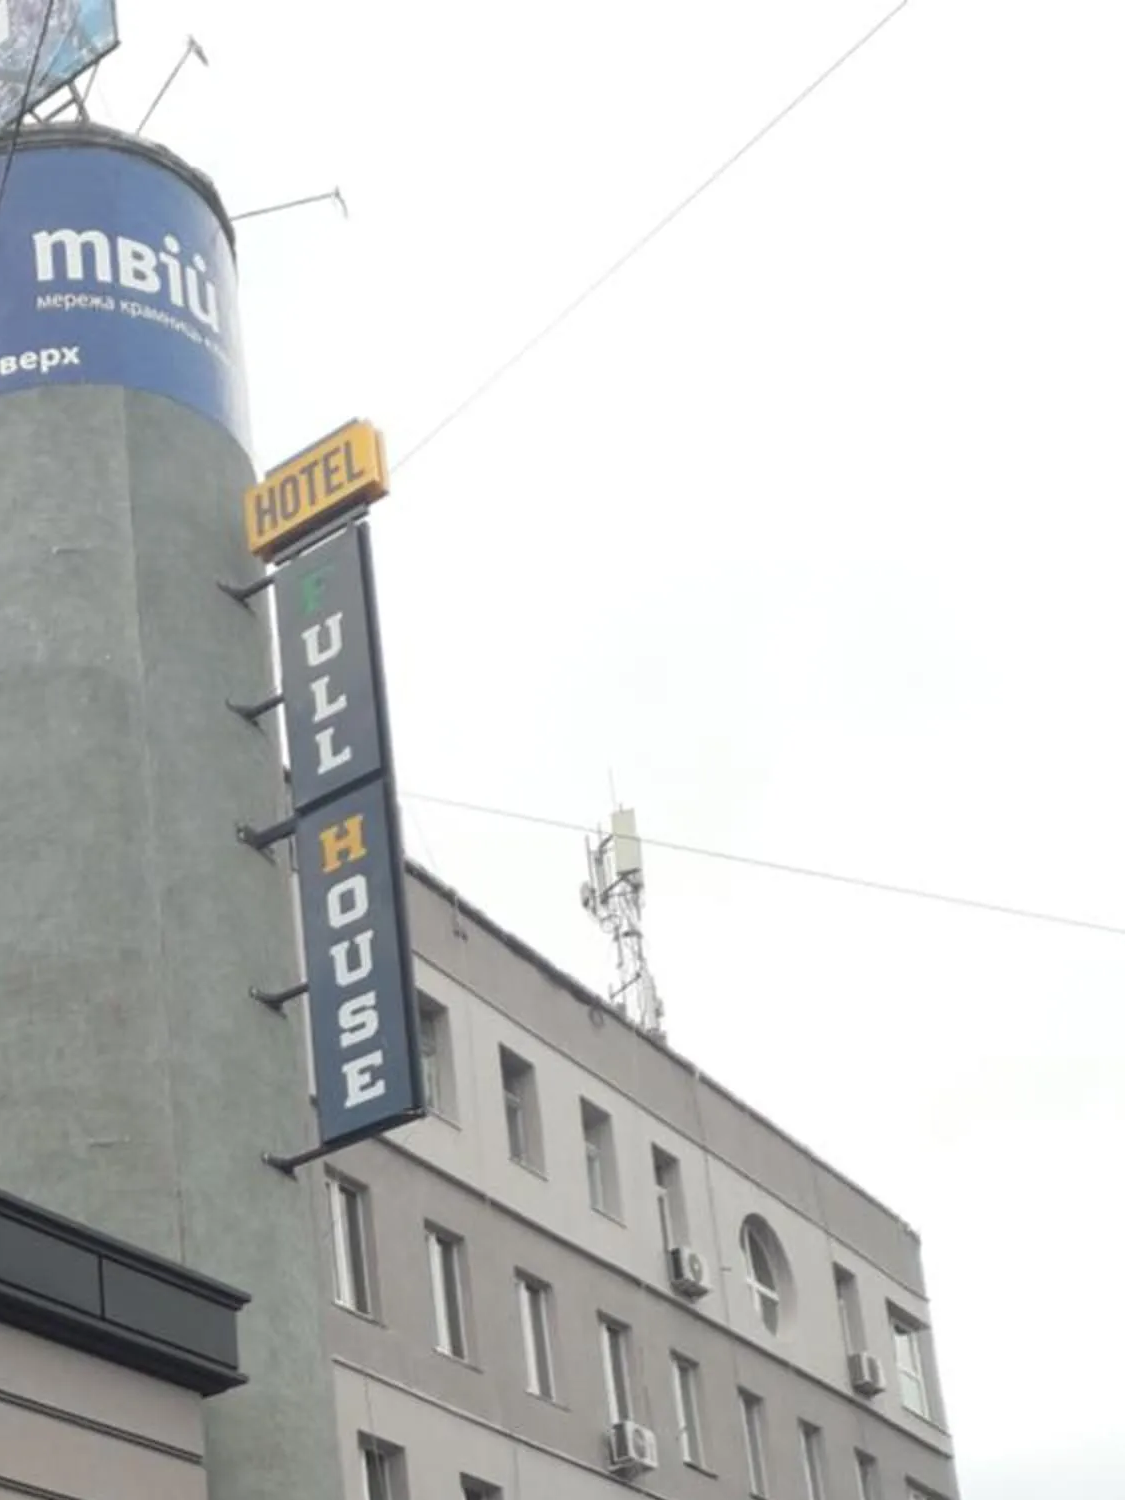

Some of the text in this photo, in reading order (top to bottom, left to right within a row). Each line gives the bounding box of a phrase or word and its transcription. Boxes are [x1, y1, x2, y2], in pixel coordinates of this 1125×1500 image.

[36, 293, 115, 313] мережа
[254, 440, 365, 536] HOTEL
[300, 564, 351, 776] FULL
[318, 813, 387, 1110] HOUSE
